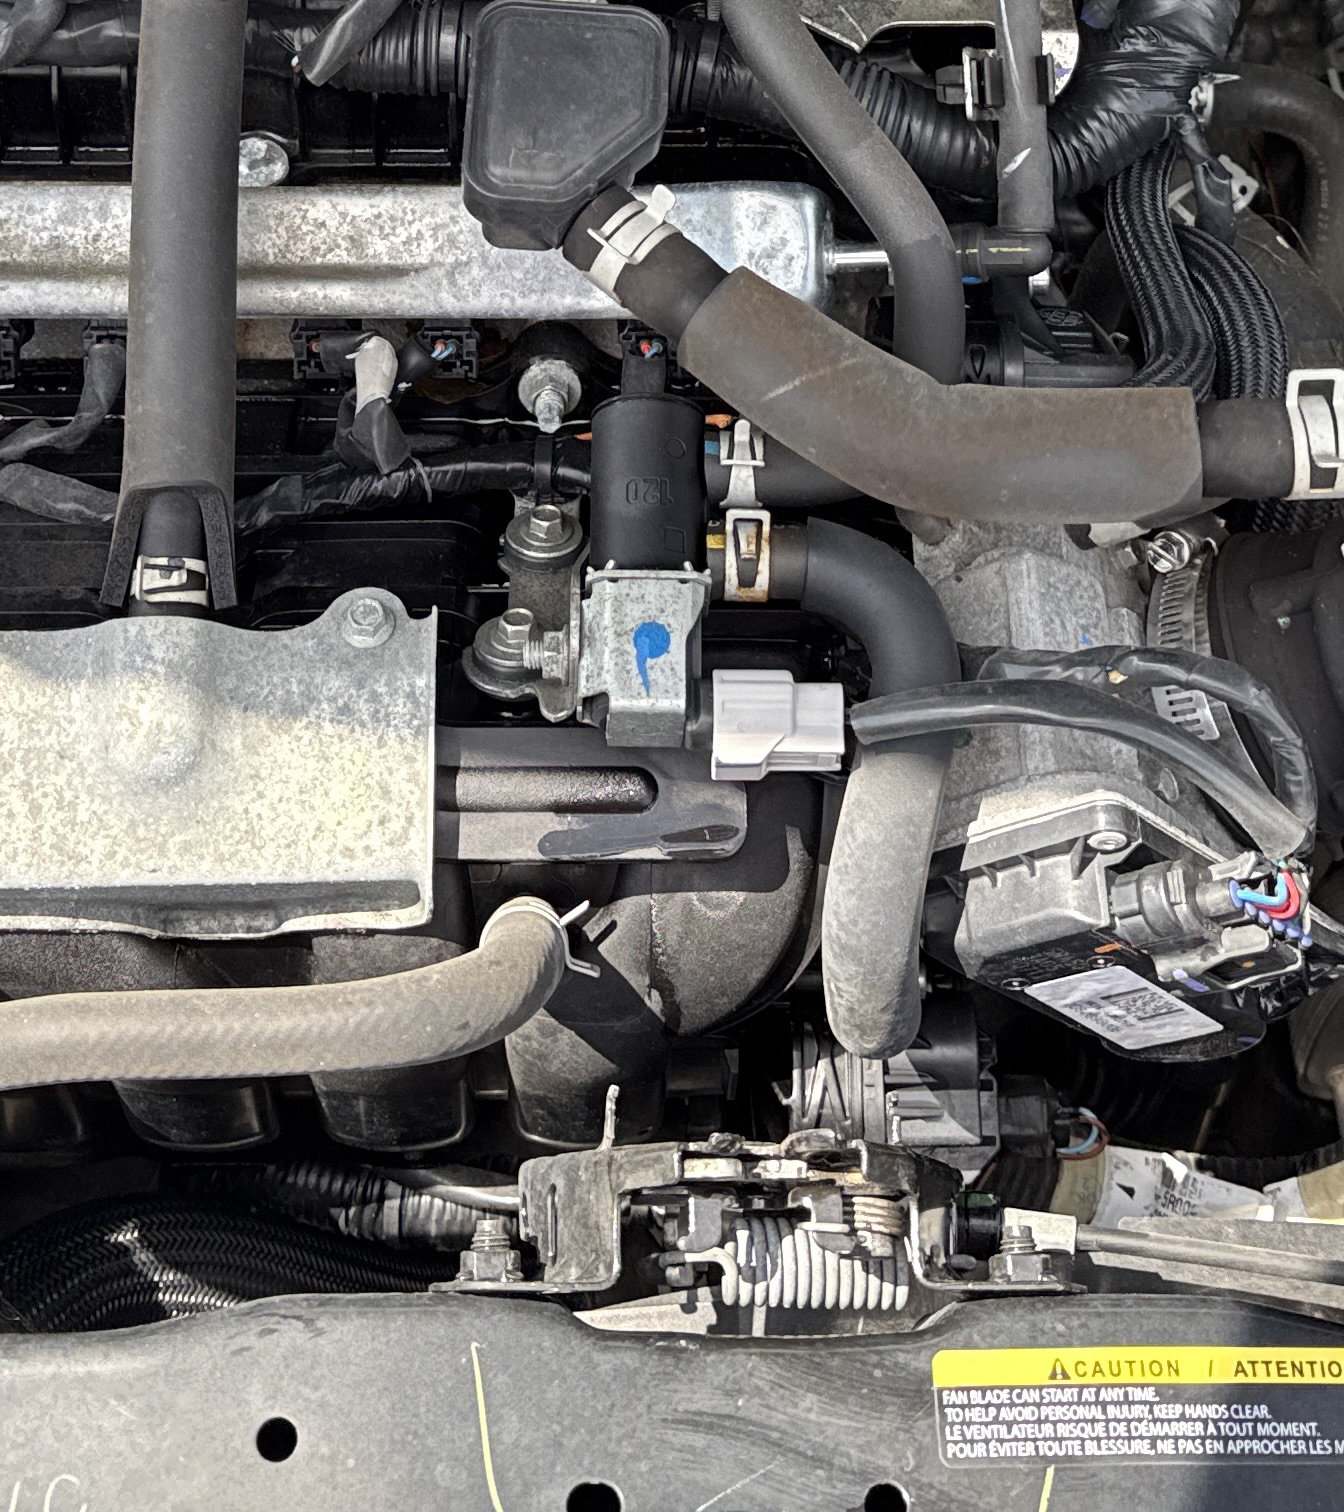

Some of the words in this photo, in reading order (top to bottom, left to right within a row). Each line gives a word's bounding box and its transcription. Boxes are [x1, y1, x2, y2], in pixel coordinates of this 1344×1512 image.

[625, 477, 674, 506] 120
[1074, 1360, 1180, 1378] CAUTION
[1208, 1360, 1213, 1377] /
[942, 1390, 968, 1405] FAN
[969, 1390, 1011, 1405] BLADE
[1012, 1388, 1040, 1404] CAN
[1042, 1388, 1079, 1403] START
[1081, 1388, 1096, 1402] AT
[1099, 1387, 1126, 1402] ANY
[1126, 1386, 1160, 1402] TIME.
[944, 1408, 963, 1422] TO
[965, 1407, 996, 1422] HELP
[999, 1407, 1039, 1421] AVOID
[1040, 1406, 1105, 1421] PERSONAL
[1107, 1405, 1152, 1421] INJURY,
[1154, 1404, 1183, 1419] KEEP
[1185, 1404, 1229, 1419] HANDS
[1229, 1404, 1272, 1419] CLEAR.
[945, 1425, 963, 1440] LE
[963, 1423, 1055, 1439] VENTILATEUR
[1056, 1422, 1107, 1438] RISQUE
[1108, 1422, 1129, 1437] DE
[1130, 1419, 1204, 1437] DÉMARRER
[1207, 1418, 1218, 1436] À
[1218, 1421, 1254, 1436] TOUT
[1257, 1422, 1321, 1437] MOMENT.
[947, 1443, 987, 1459] POUR
[989, 1439, 1035, 1457] ÉVITER
[1036, 1441, 1083, 1457] TOUTE
[1084, 1440, 1155, 1456] BLESSURE,
[1156, 1440, 1176, 1455] NE
[1178, 1440, 1204, 1454] PAS
[1205, 1440, 1224, 1455] EN
[1226, 1439, 1308, 1455] APPROCHER
[1309, 1439, 1332, 1455] LES
